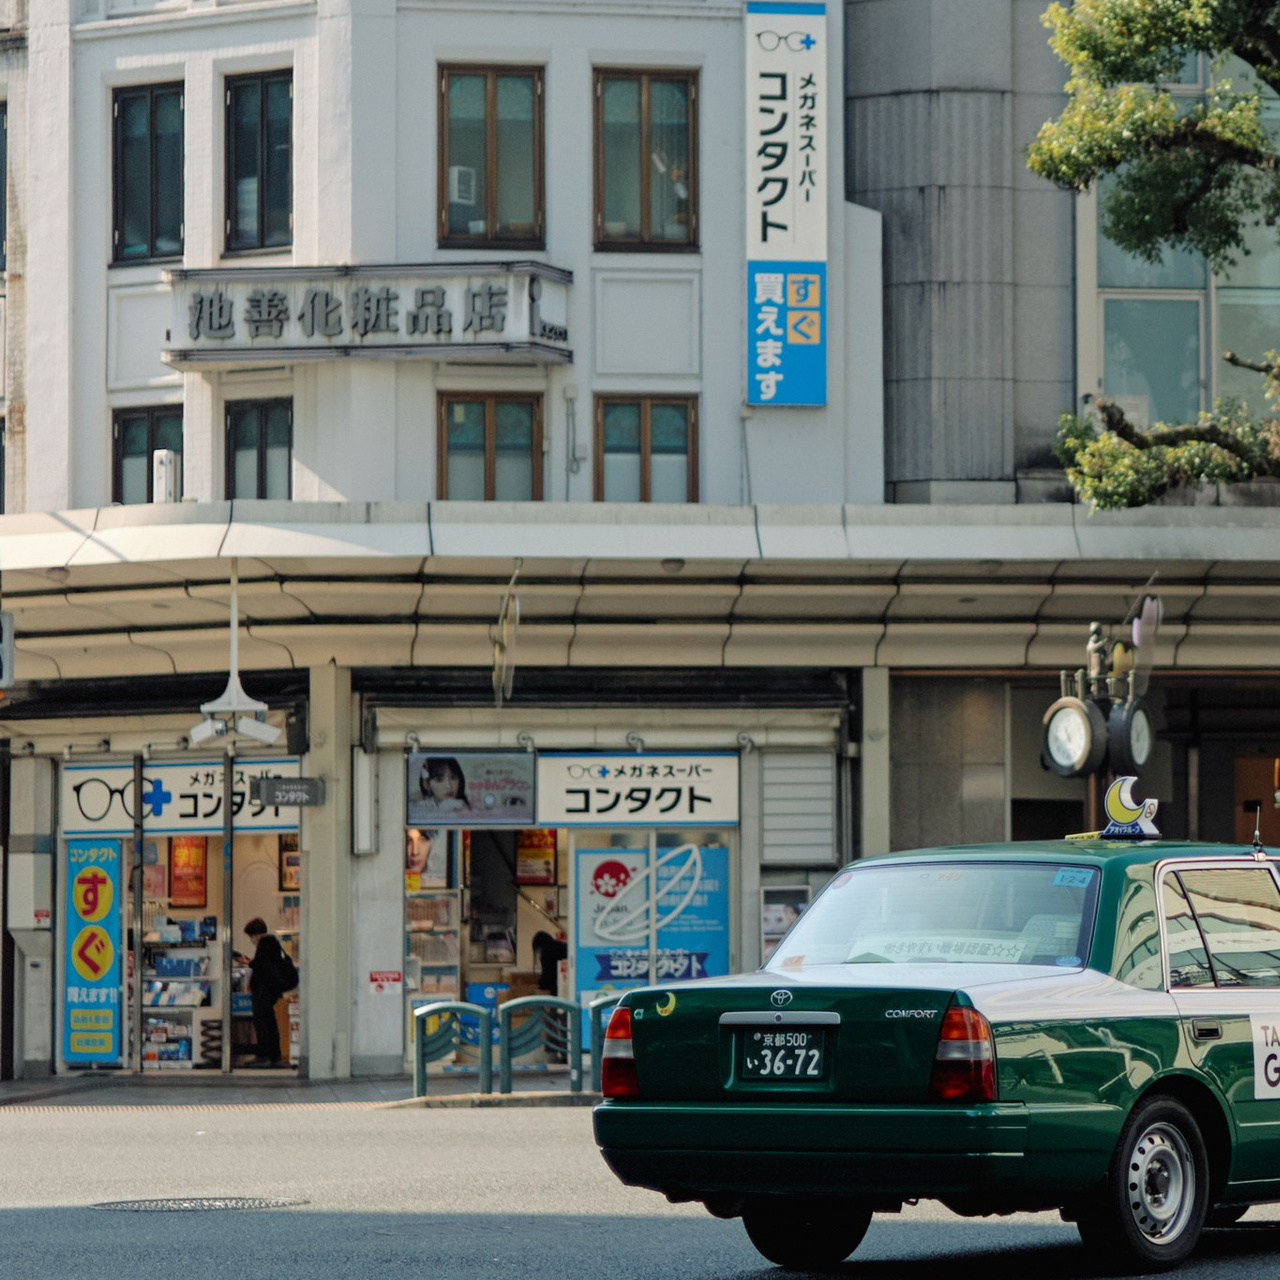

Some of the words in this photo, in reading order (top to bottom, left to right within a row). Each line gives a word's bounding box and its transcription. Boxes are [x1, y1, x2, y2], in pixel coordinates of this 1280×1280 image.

[756, 71, 789, 243] コンタクト
[798, 72, 818, 203] メガネスーパー
[186, 282, 509, 340] 池善化粧品店
[754, 273, 785, 401] 買えます
[789, 276, 818, 342] すぐ
[614, 764, 712, 778] メガネスーパー
[565, 787, 713, 814] コンタクト
[69, 847, 117, 863] コンタクト
[76, 871, 108, 976] すぐ
[884, 1009, 938, 1019] COMFORT
[746, 1057, 759, 1070] い
[759, 1049, 820, 1076] 36-72
